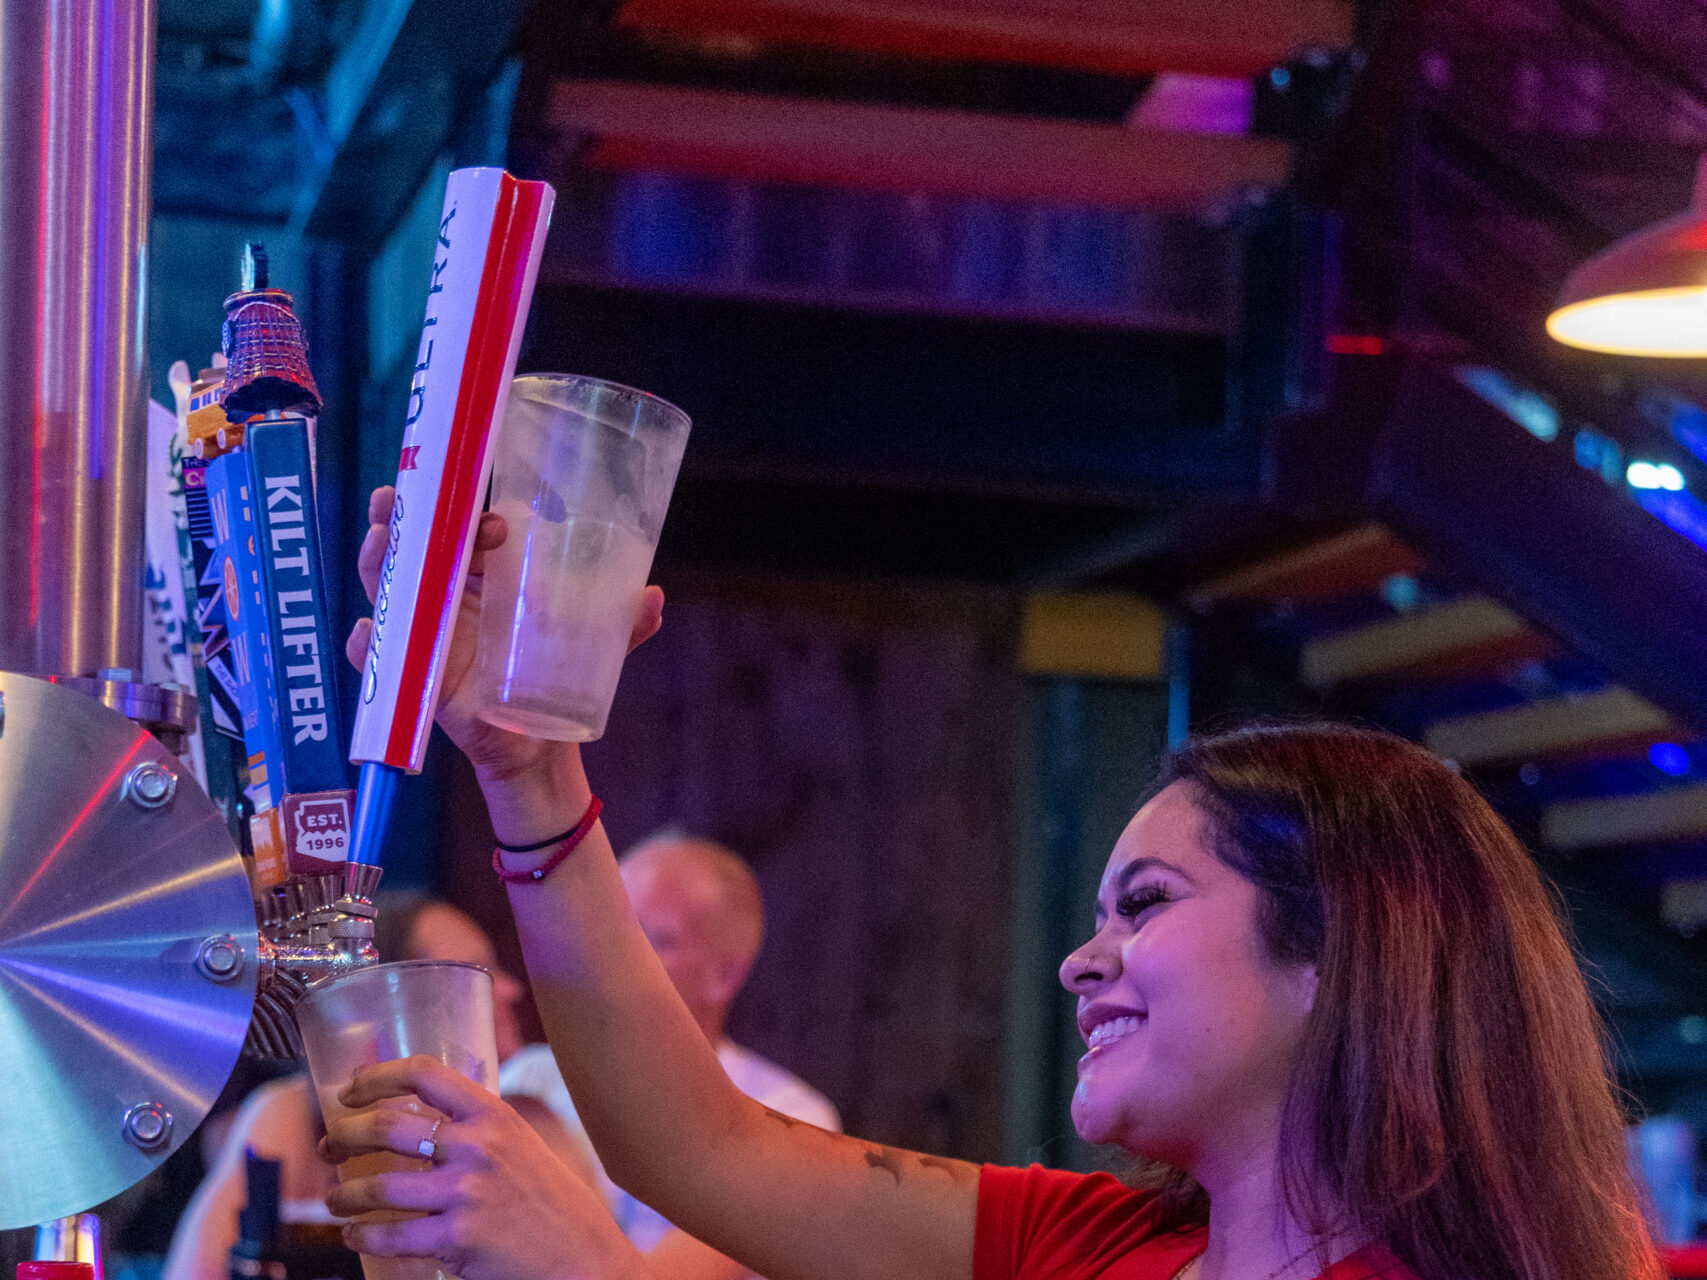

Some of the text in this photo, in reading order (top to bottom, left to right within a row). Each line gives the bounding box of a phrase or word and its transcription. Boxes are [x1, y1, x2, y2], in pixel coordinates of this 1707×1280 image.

[264, 474, 329, 746] KILT LIFTER
[306, 813, 343, 827] EST.
[306, 837, 345, 850] 1996
